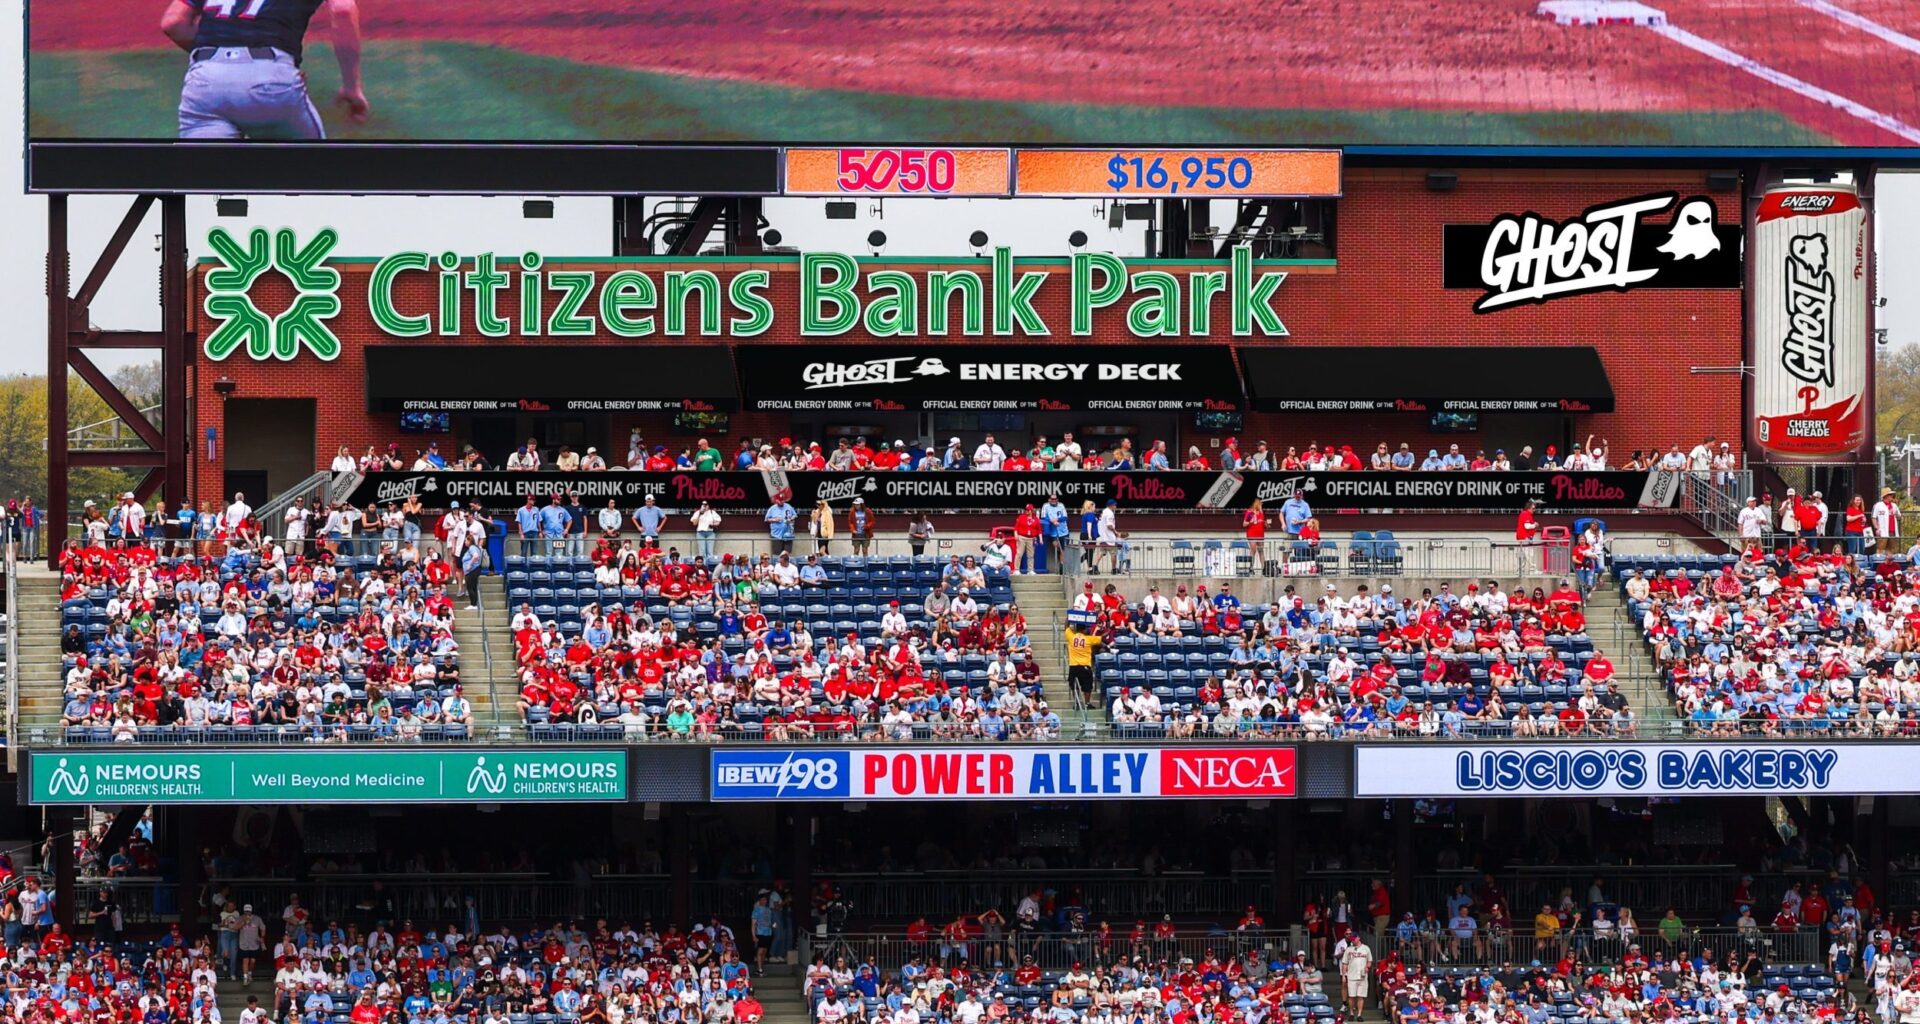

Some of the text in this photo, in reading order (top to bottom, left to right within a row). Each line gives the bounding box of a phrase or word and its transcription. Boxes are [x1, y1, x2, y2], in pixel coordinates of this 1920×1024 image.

[1107, 155, 1253, 194] $16,950
[1780, 195, 1835, 208] ENERGY
[1478, 196, 1674, 310] GHOST
[368, 246, 1291, 338] Citizens Bank Park
[1782, 255, 1836, 388] GHOST
[802, 357, 1182, 389] GHOST ENERGY DECK
[403, 400, 438, 410] OFFICIAL
[440, 400, 471, 410] ENERGY
[473, 400, 498, 410] DRINK
[518, 399, 550, 410] Phillies
[567, 400, 603, 410] OFFICIAL
[604, 400, 635, 410] ENERGY
[637, 400, 662, 410] DRINK
[682, 399, 714, 410] Phillies
[757, 400, 793, 410] OFFICIAL
[794, 400, 827, 410] ENERGY
[827, 400, 853, 410] DRINK
[873, 399, 905, 410] Phillies
[922, 400, 958, 410] OFFICIAL
[959, 400, 992, 410] ENERGY
[992, 400, 1018, 410] DRINK
[1038, 399, 1070, 410] Phillies
[1087, 400, 1124, 410] OFFICIAL
[1125, 400, 1158, 410] ENERGY
[1158, 400, 1184, 410] DRINK
[1204, 399, 1236, 410] Phillies
[1279, 400, 1316, 410] OFFICIAL
[1316, 400, 1349, 410] ENERGY
[1349, 400, 1375, 410] DRINK
[1395, 399, 1427, 410] Phillies
[1443, 400, 1480, 410] OFFICIAL
[1480, 400, 1513, 410] ENERGY
[1513, 400, 1538, 410] DRINK
[1559, 399, 1590, 410] Phillies
[1788, 419, 1829, 429] CHERRY
[1786, 428, 1831, 437] LIMEADE
[377, 473, 746, 504] GHOST OFFICIAL ENERGY DRINK OF THE Phillies
[816, 473, 1185, 504] GHOST OFFICIAL ENERGY DRINK OF THE Phillies
[1255, 473, 1625, 504] GHOST OFFICIAL ENERGY DRINK OF THE Phillies
[1073, 636, 1086, 649] 84
[96, 764, 201, 781] NEMOURS
[513, 762, 618, 779] NEMOURS
[717, 757, 838, 790] IBEW 98
[863, 752, 1149, 796] POWER ALLEY
[1172, 755, 1294, 790] NECA
[1456, 749, 1839, 791] LISCIO'S BAKERY
[252, 773, 425, 789] Well Beyond Medicine
[512, 780, 576, 794] CHILDREN'S
[95, 783, 159, 796] CHILDREN'S
